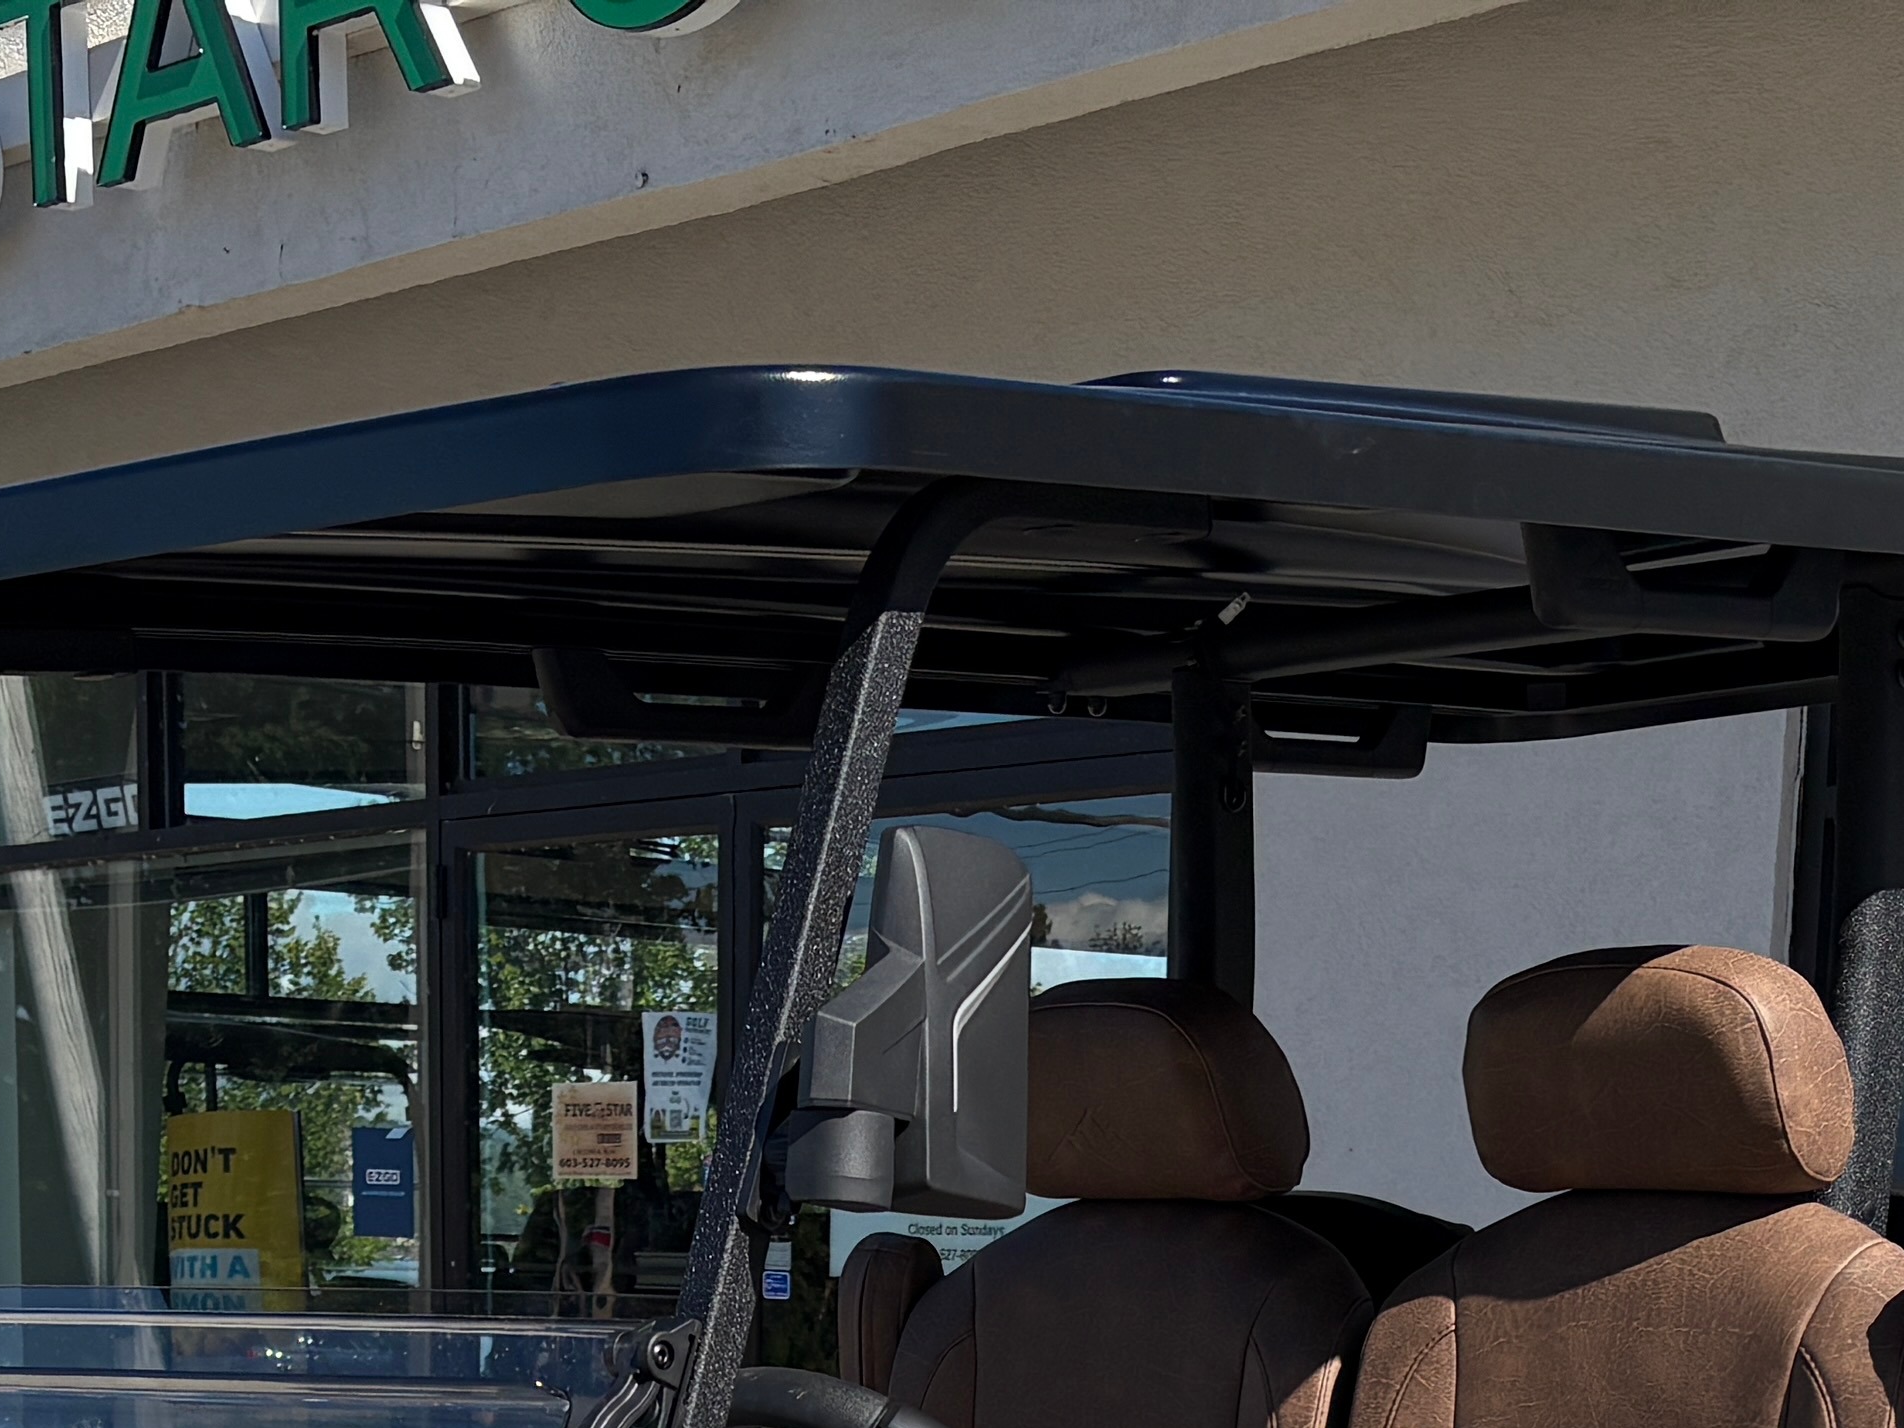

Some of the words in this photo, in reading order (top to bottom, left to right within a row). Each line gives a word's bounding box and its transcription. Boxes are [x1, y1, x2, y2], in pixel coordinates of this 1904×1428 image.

[564, 1103, 592, 1118] FIVE
[607, 1103, 633, 1118] STAR
[171, 1146, 236, 1177] DON'T
[171, 1182, 203, 1208] GET
[170, 1213, 246, 1240] STUCK
[908, 1223, 942, 1236] Closed
[945, 1225, 958, 1236] on
[961, 1223, 1005, 1239] Sundays
[227, 1254, 251, 1279] A
